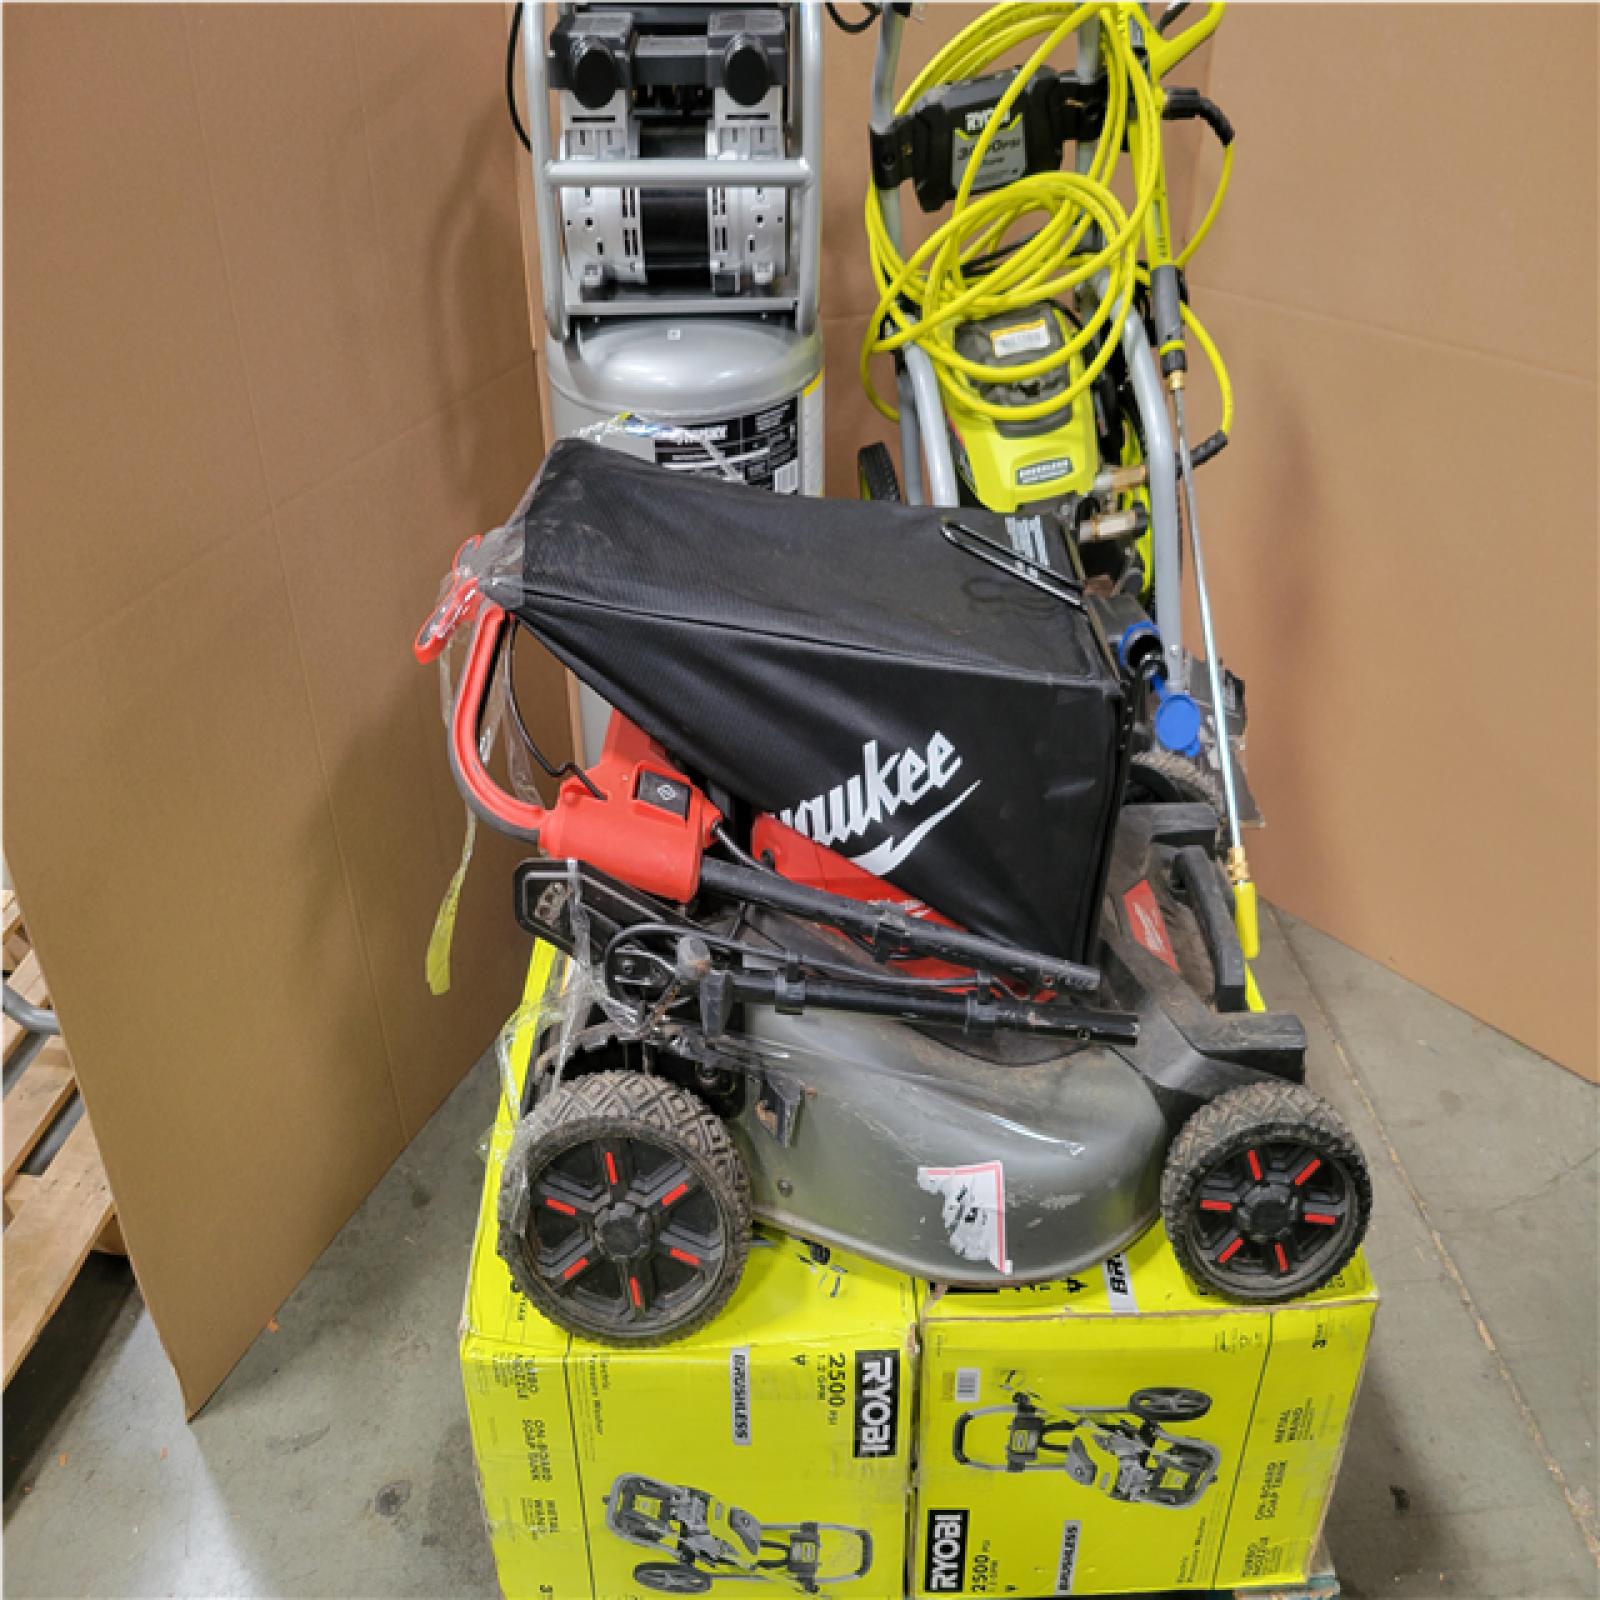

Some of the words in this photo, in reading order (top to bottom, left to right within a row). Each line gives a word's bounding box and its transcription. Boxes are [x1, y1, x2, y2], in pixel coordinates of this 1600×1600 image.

[733, 1354, 748, 1440] BRUSHLESS
[829, 1353, 846, 1407] 2500
[861, 1356, 894, 1452] RYOBI
[534, 1419, 552, 1482] ON-BOARD
[931, 1514, 961, 1591] RYOBI
[970, 1554, 991, 1593] 2500
[1057, 1525, 1079, 1591] BRUSHLESS
